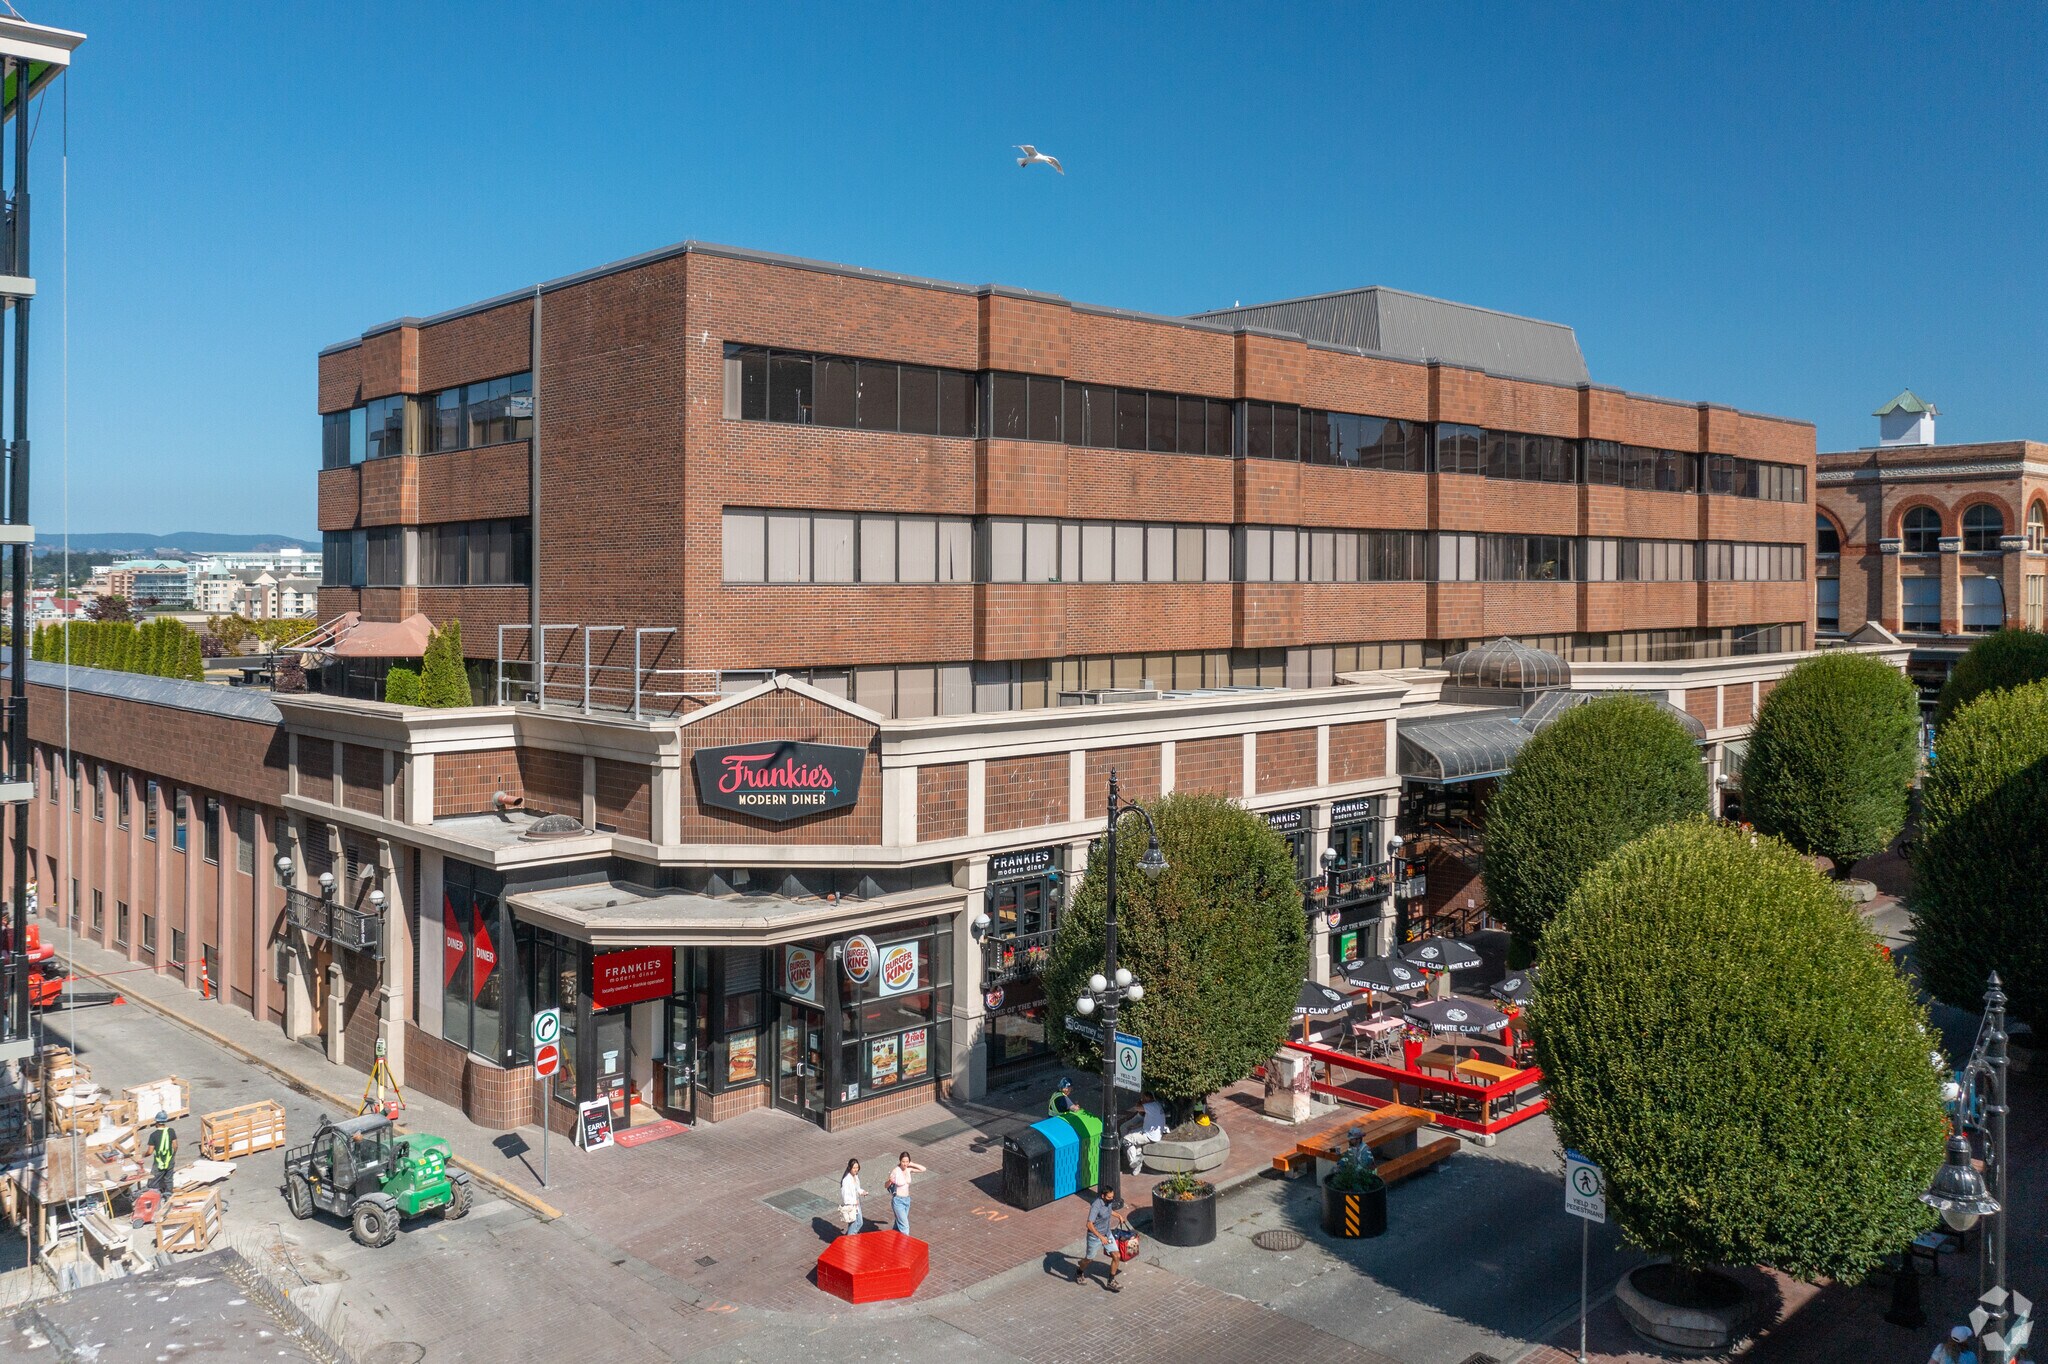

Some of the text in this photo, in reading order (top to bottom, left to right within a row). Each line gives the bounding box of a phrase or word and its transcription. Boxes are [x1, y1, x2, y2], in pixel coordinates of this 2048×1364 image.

[718, 752, 833, 793] Frankie's
[739, 793, 826, 805] MODERN DINER
[998, 864, 1045, 876] modern diner
[447, 936, 464, 952] DINER
[476, 947, 494, 963] DINER
[846, 948, 868, 958] BURGER
[790, 960, 810, 970] BURGER
[847, 957, 868, 968] KING
[885, 951, 912, 972] BURGER
[1427, 962, 1444, 970] CLAW
[1464, 960, 1480, 968] CLAW
[610, 970, 657, 983] modern diner
[790, 968, 811, 983] KING
[886, 960, 913, 984] KING
[1350, 978, 1390, 992] WHITE CLAW
[1395, 980, 1426, 992] WHITE CLAW
[1007, 1006, 1016, 1014] OF
[1017, 1002, 1032, 1010] THE
[1342, 1000, 1352, 1010] CLAW
[1074, 1021, 1096, 1036] Courtney
[1434, 1024, 1481, 1032] WHITE CLAW
[1496, 1019, 1509, 1028] CLAW
[905, 1032, 910, 1044] 2
[910, 1034, 919, 1042] FOR
[920, 1030, 925, 1040] 6
[588, 1121, 606, 1131] EARLY
[1573, 1198, 1588, 1208] YIELD
[1567, 1203, 1604, 1219] PEDESTRIANS
